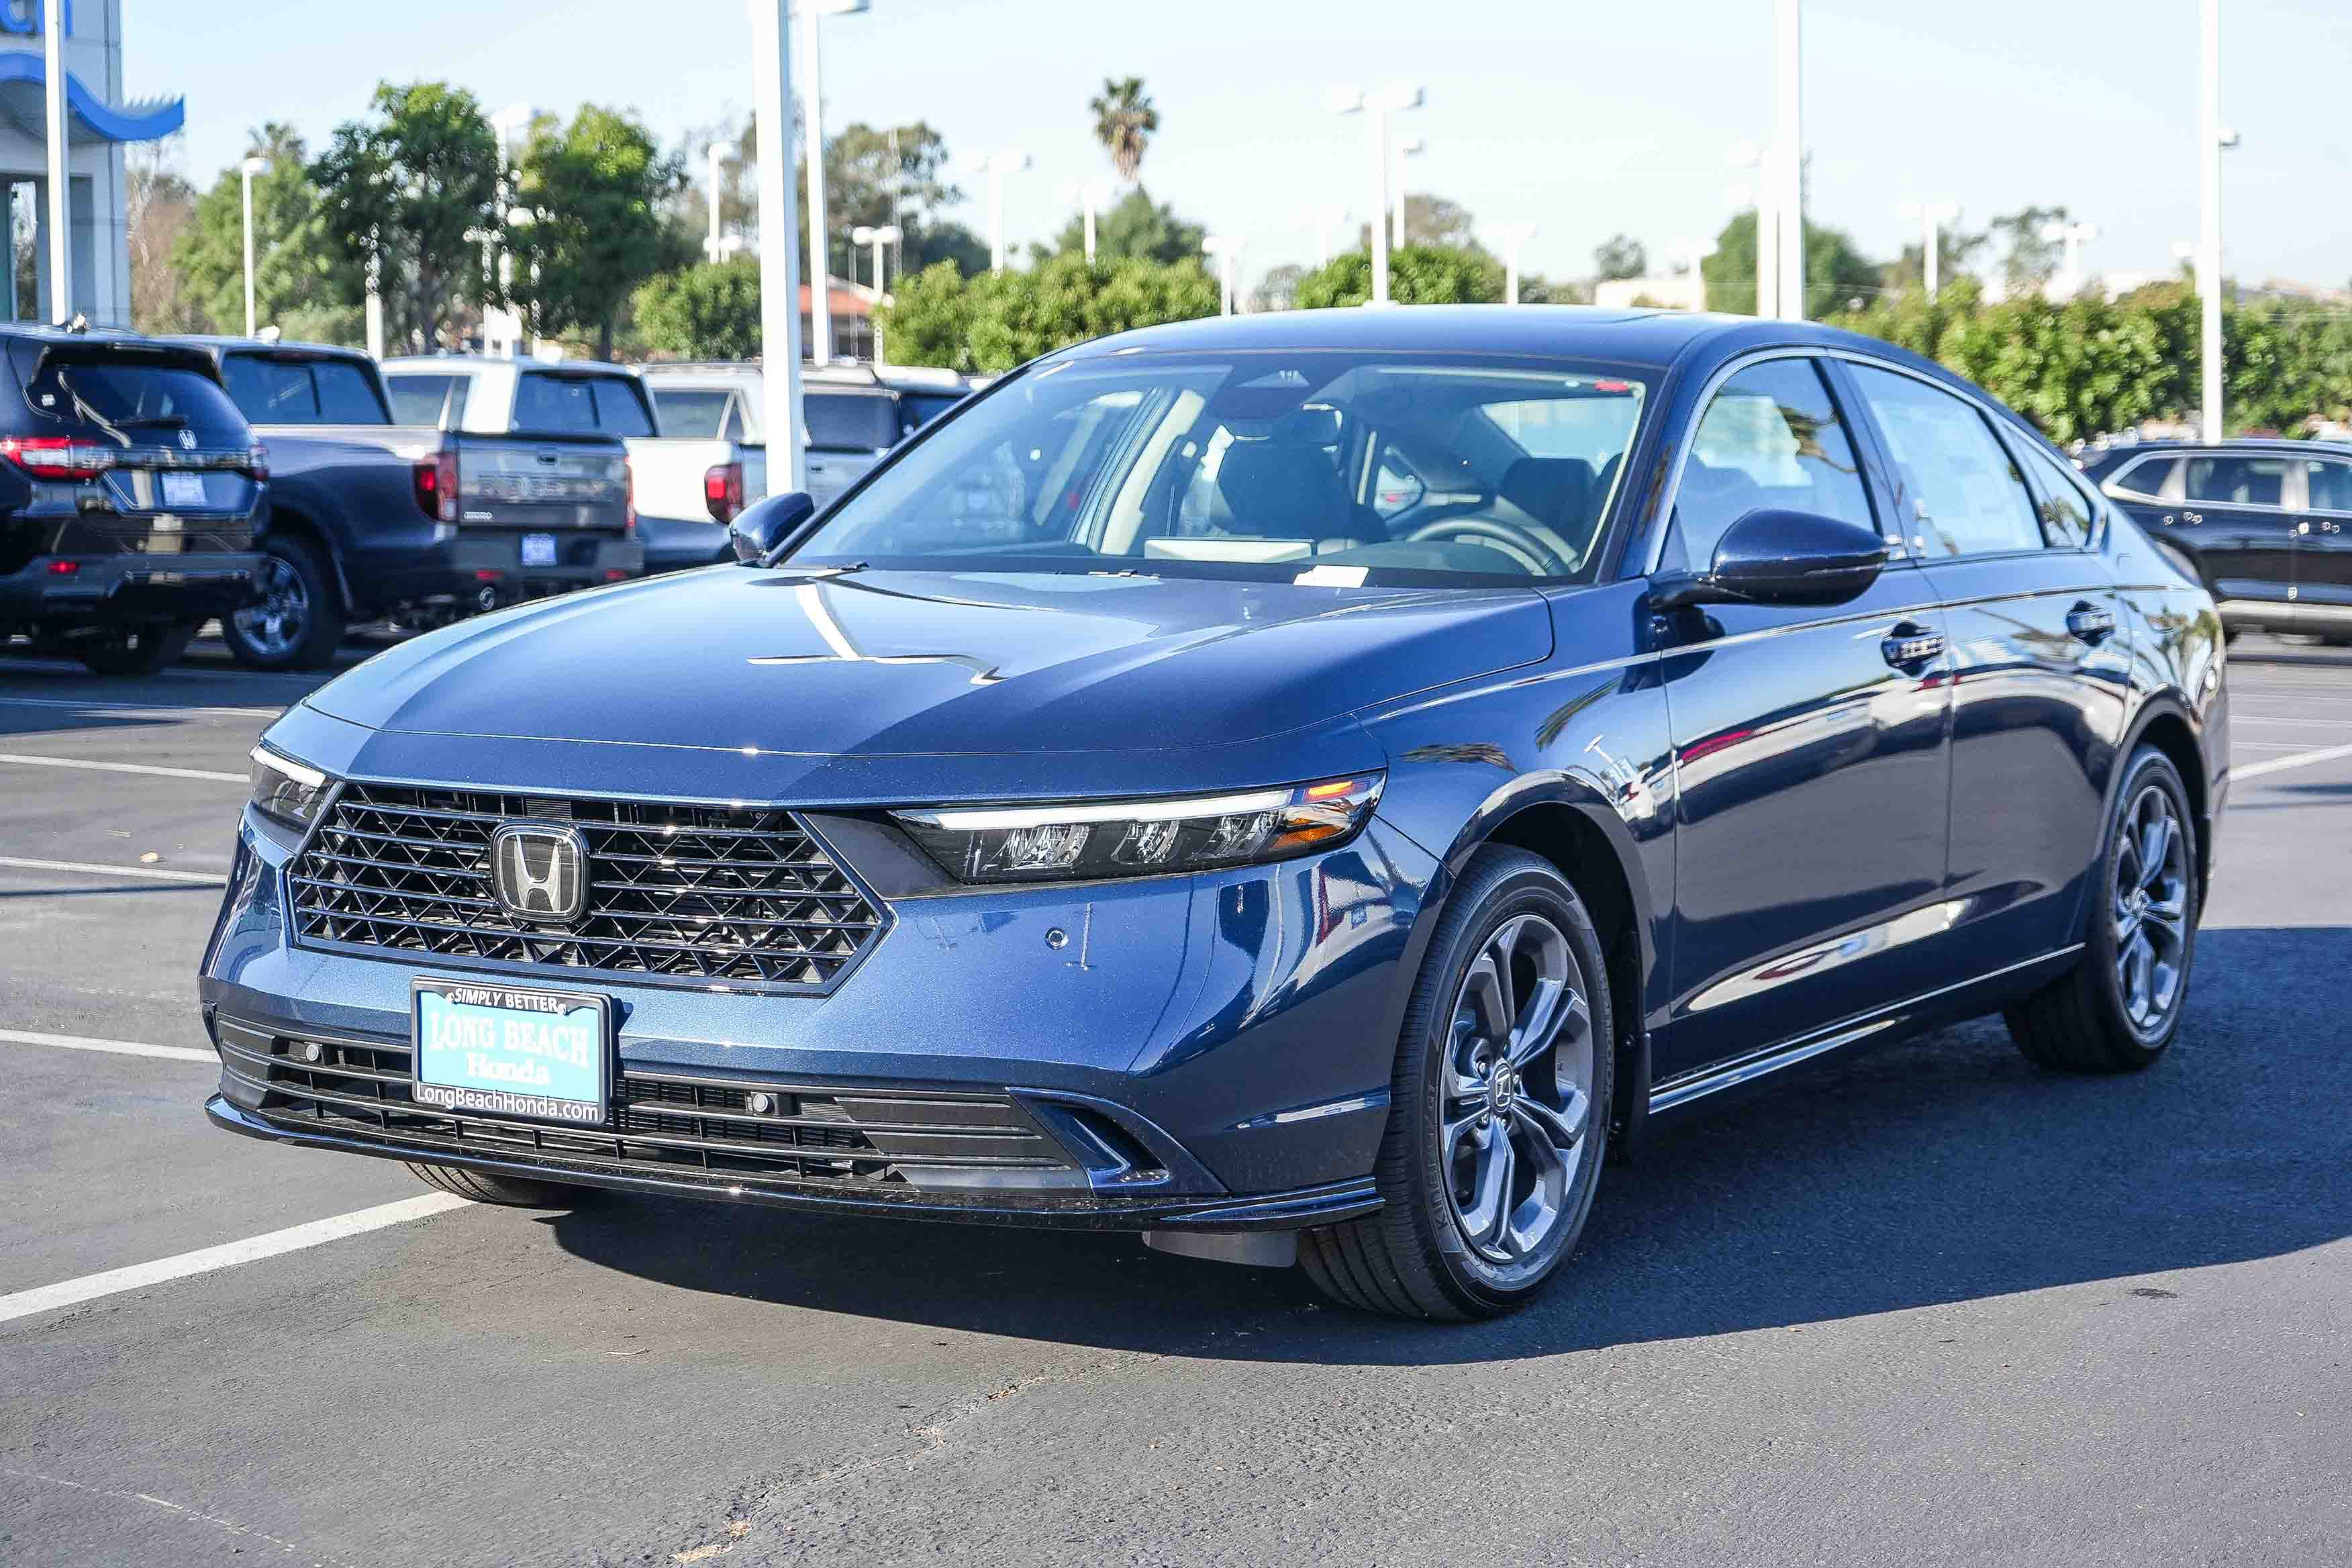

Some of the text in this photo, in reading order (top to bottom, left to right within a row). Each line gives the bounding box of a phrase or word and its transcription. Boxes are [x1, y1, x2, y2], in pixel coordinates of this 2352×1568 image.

[454, 988, 558, 1011] SIMPLY BETTER
[430, 1011, 589, 1069] LONG BEACH
[466, 1052, 551, 1085] Honda
[416, 1086, 599, 1121] LongBeachHonda.com
